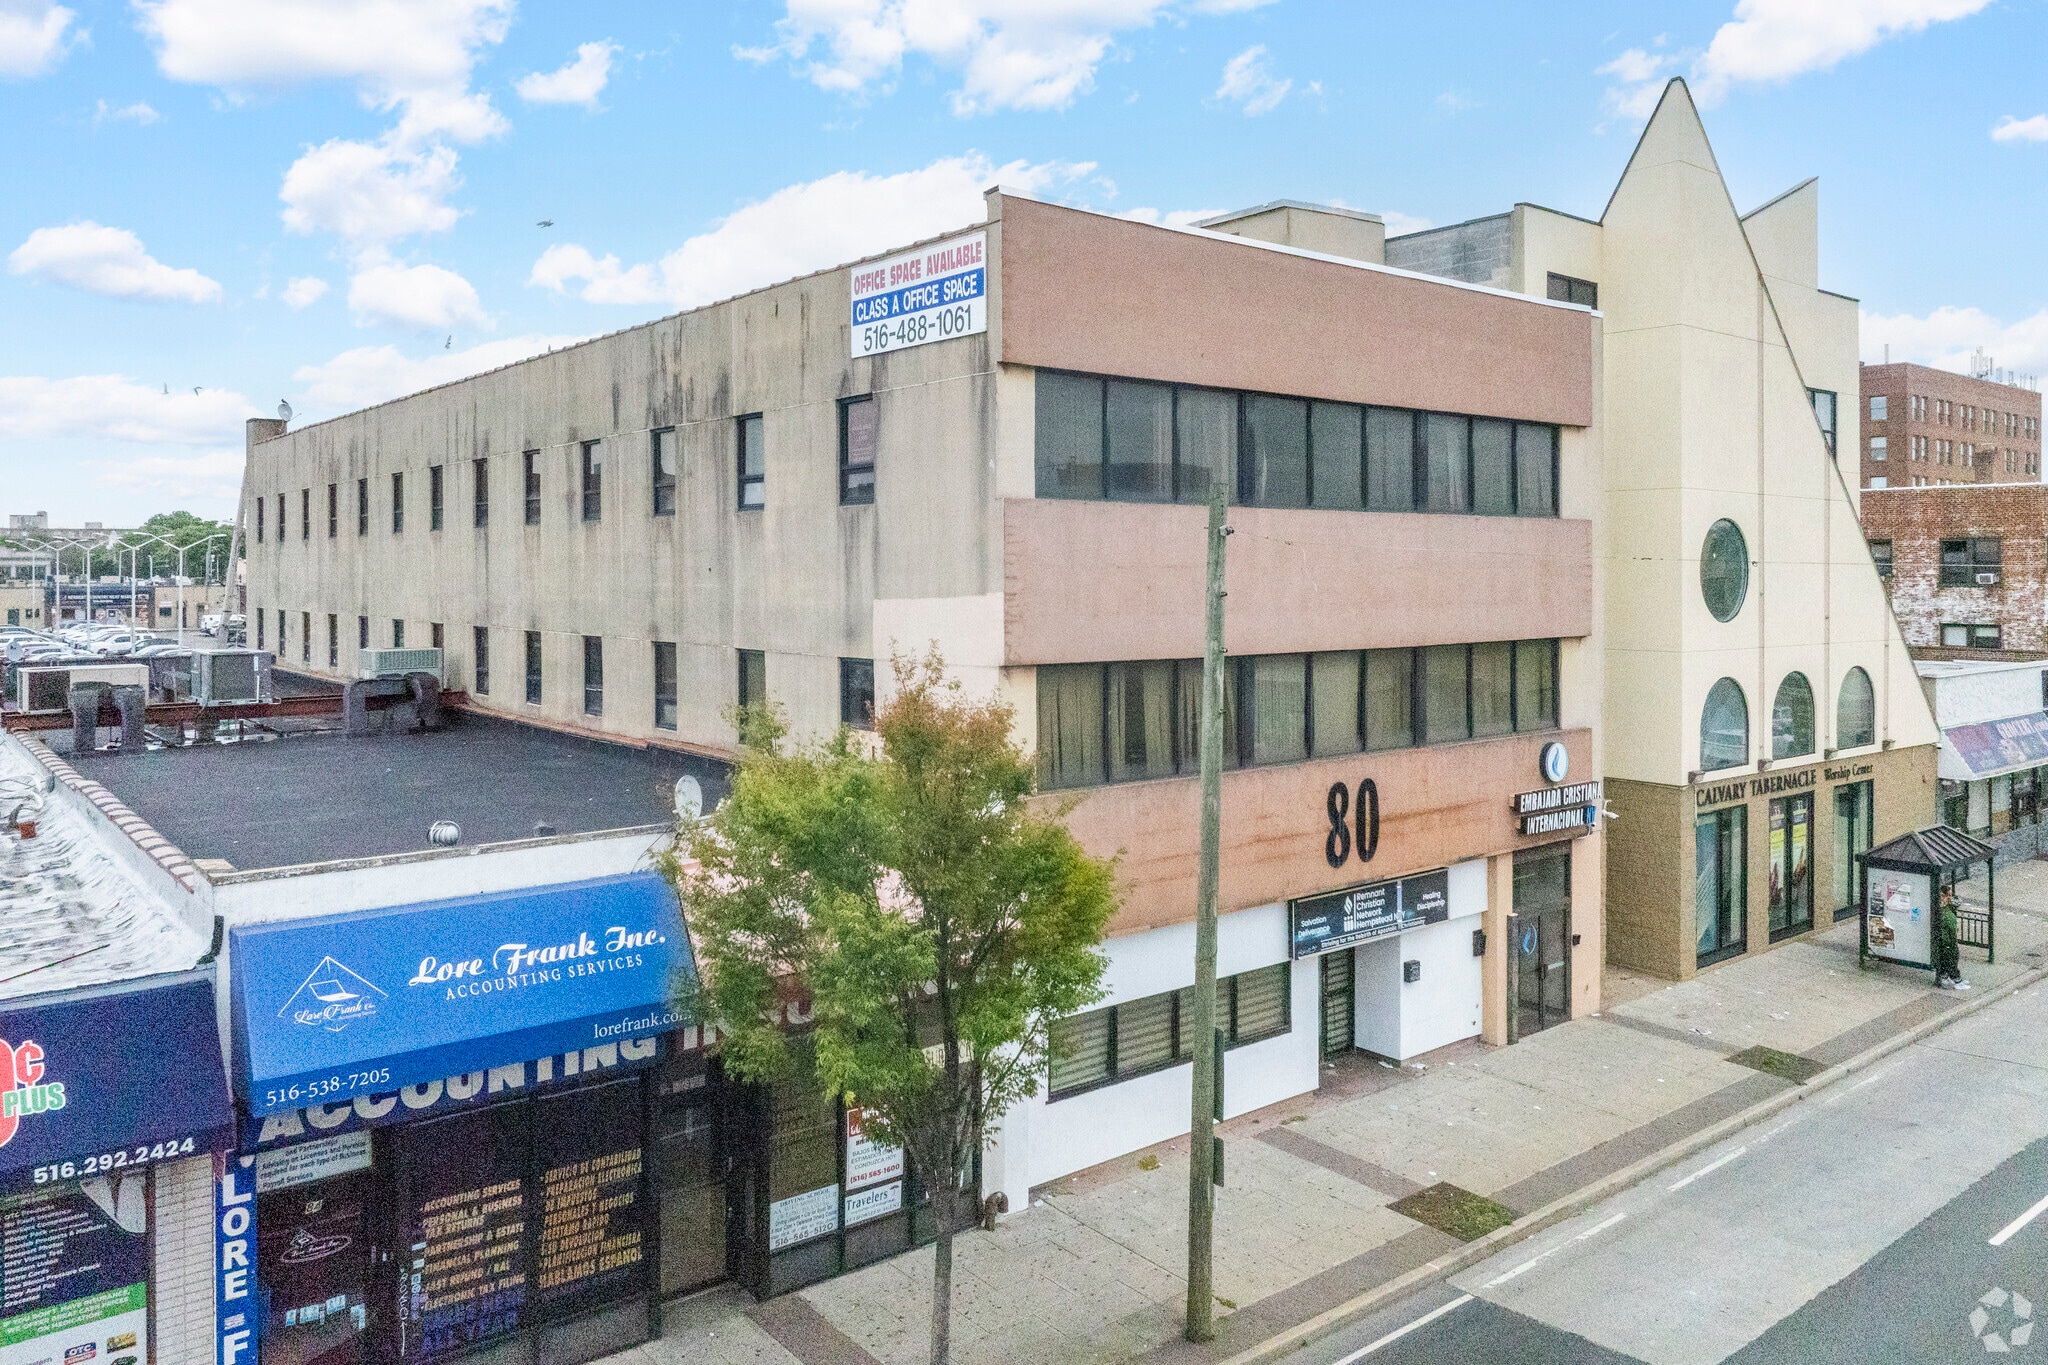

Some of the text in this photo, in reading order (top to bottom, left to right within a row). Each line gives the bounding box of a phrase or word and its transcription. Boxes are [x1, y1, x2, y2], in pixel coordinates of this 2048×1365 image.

[854, 241, 982, 295] OFFICE SPACE AVAILABLE
[856, 274, 977, 322] CLASS A OFFICE SPACE
[864, 304, 971, 351] 516-488-1061
[1696, 763, 1873, 807] CALVARY TABERNACLE Worship Center
[1520, 781, 1601, 813] EMBAJADA CRISTIANA
[1325, 778, 1379, 869] 80
[1527, 808, 1584, 834] INTERNACIONAL
[1357, 888, 1385, 900] Remnant
[1422, 891, 1441, 901] Healing
[1356, 898, 1385, 911] Christian
[1357, 907, 1382, 920] Network
[1416, 899, 1445, 911] Discipleship
[1297, 925, 1331, 938] Deliverance
[1300, 916, 1327, 928] Salvation
[1356, 914, 1395, 929] Hempstead
[1321, 938, 1339, 948] Striving
[1347, 934, 1355, 942] the
[1355, 931, 1371, 941] Rebirth
[409, 926, 666, 987] Lore Frank Inc.
[445, 953, 643, 1001] ACCOUNTING SERVICES
[294, 996, 370, 1026] Lore Frank
[266, 1067, 390, 1107] 516-538-7205
[2, 1082, 66, 1118] PLUS
[34, 1137, 195, 1184] 516.292.2424
[545, 1163, 578, 1183] SERVICIO
[850, 1173, 868, 1184] (516)
[423, 1179, 521, 1213] ACCOUNTING SERVICES
[600, 1191, 634, 1211] NEGOCIOS
[846, 1190, 888, 1211] Travelers
[4, 1212, 20, 1220] OTC
[422, 1194, 522, 1228] PERSONAL & BUSINESS
[426, 1226, 443, 1239] TAX
[496, 1222, 524, 1238] ESTATE
[775, 1222, 834, 1247] 516-565-5120
[474, 1240, 519, 1260] PLANNING
[4, 1259, 22, 1268] DMV
[499, 1274, 525, 1290] FILING
[539, 1260, 596, 1289] HABLAMOS
[4, 1291, 24, 1300] Copy
[69, 1343, 92, 1356] OTC
